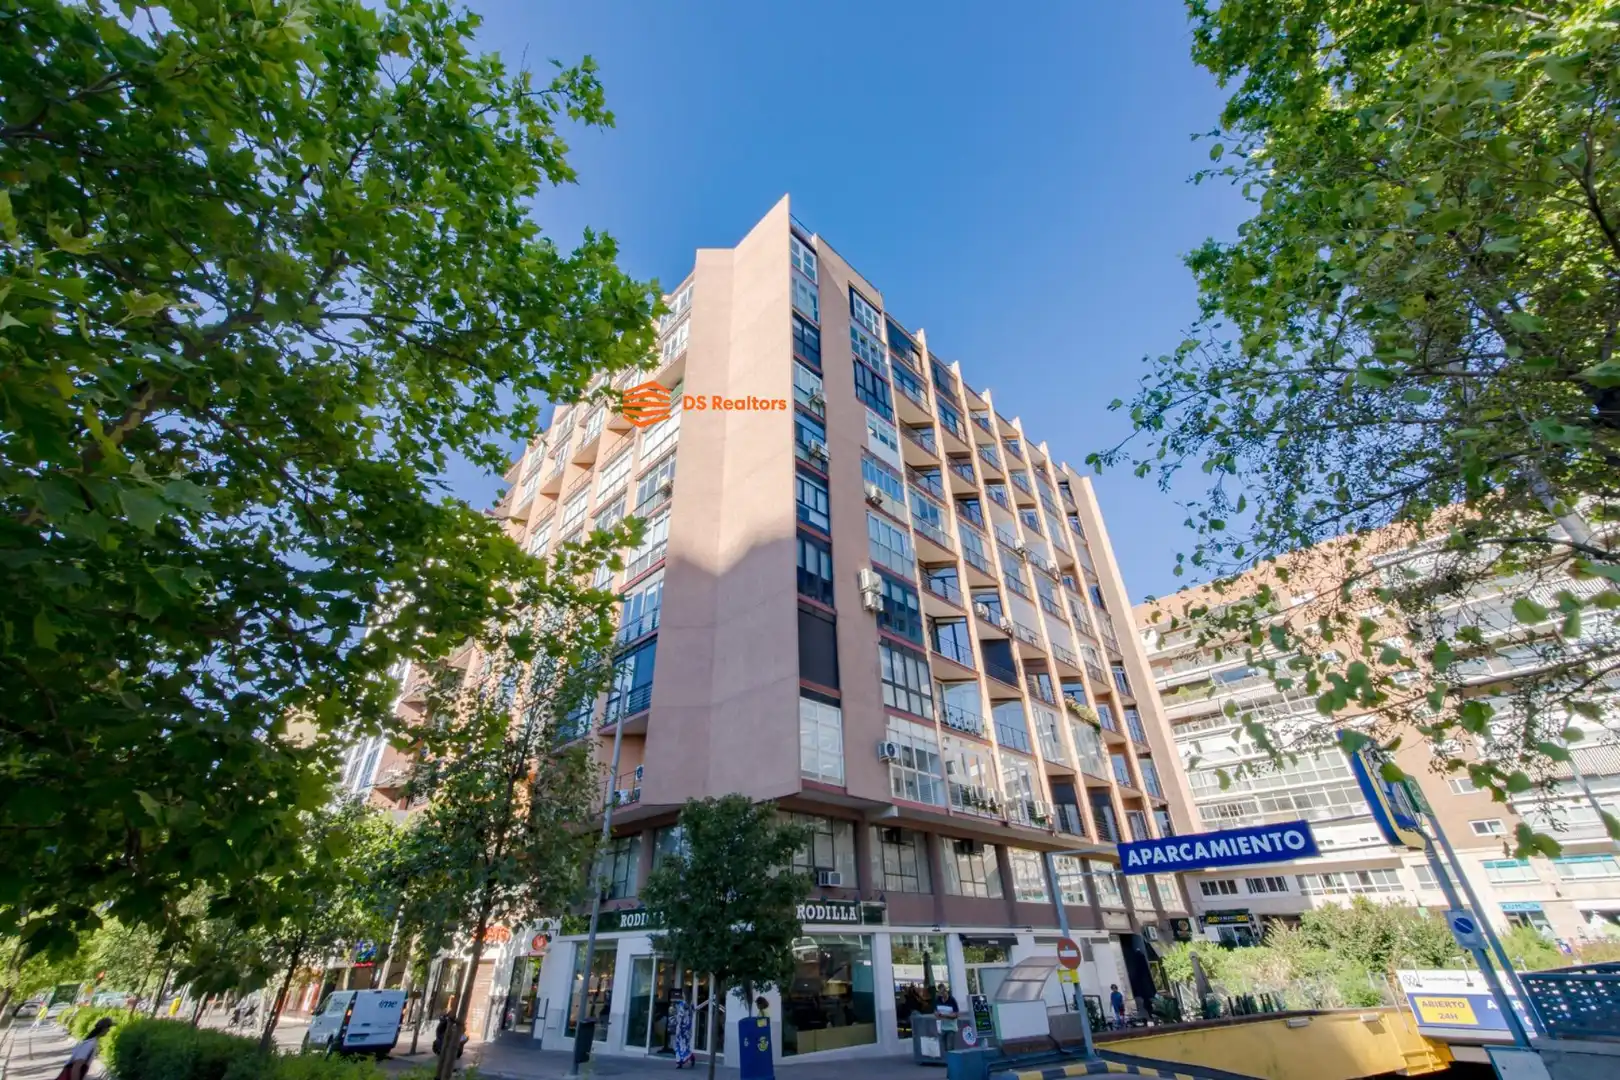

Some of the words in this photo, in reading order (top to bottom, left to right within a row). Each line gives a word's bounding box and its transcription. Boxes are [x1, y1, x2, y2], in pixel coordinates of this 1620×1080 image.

[1127, 830, 1306, 867] APARCAMIENTO
[796, 903, 857, 921] RODILLA
[1421, 1000, 1465, 1009] ABIERTO
[1439, 1012, 1459, 1020] 24H
